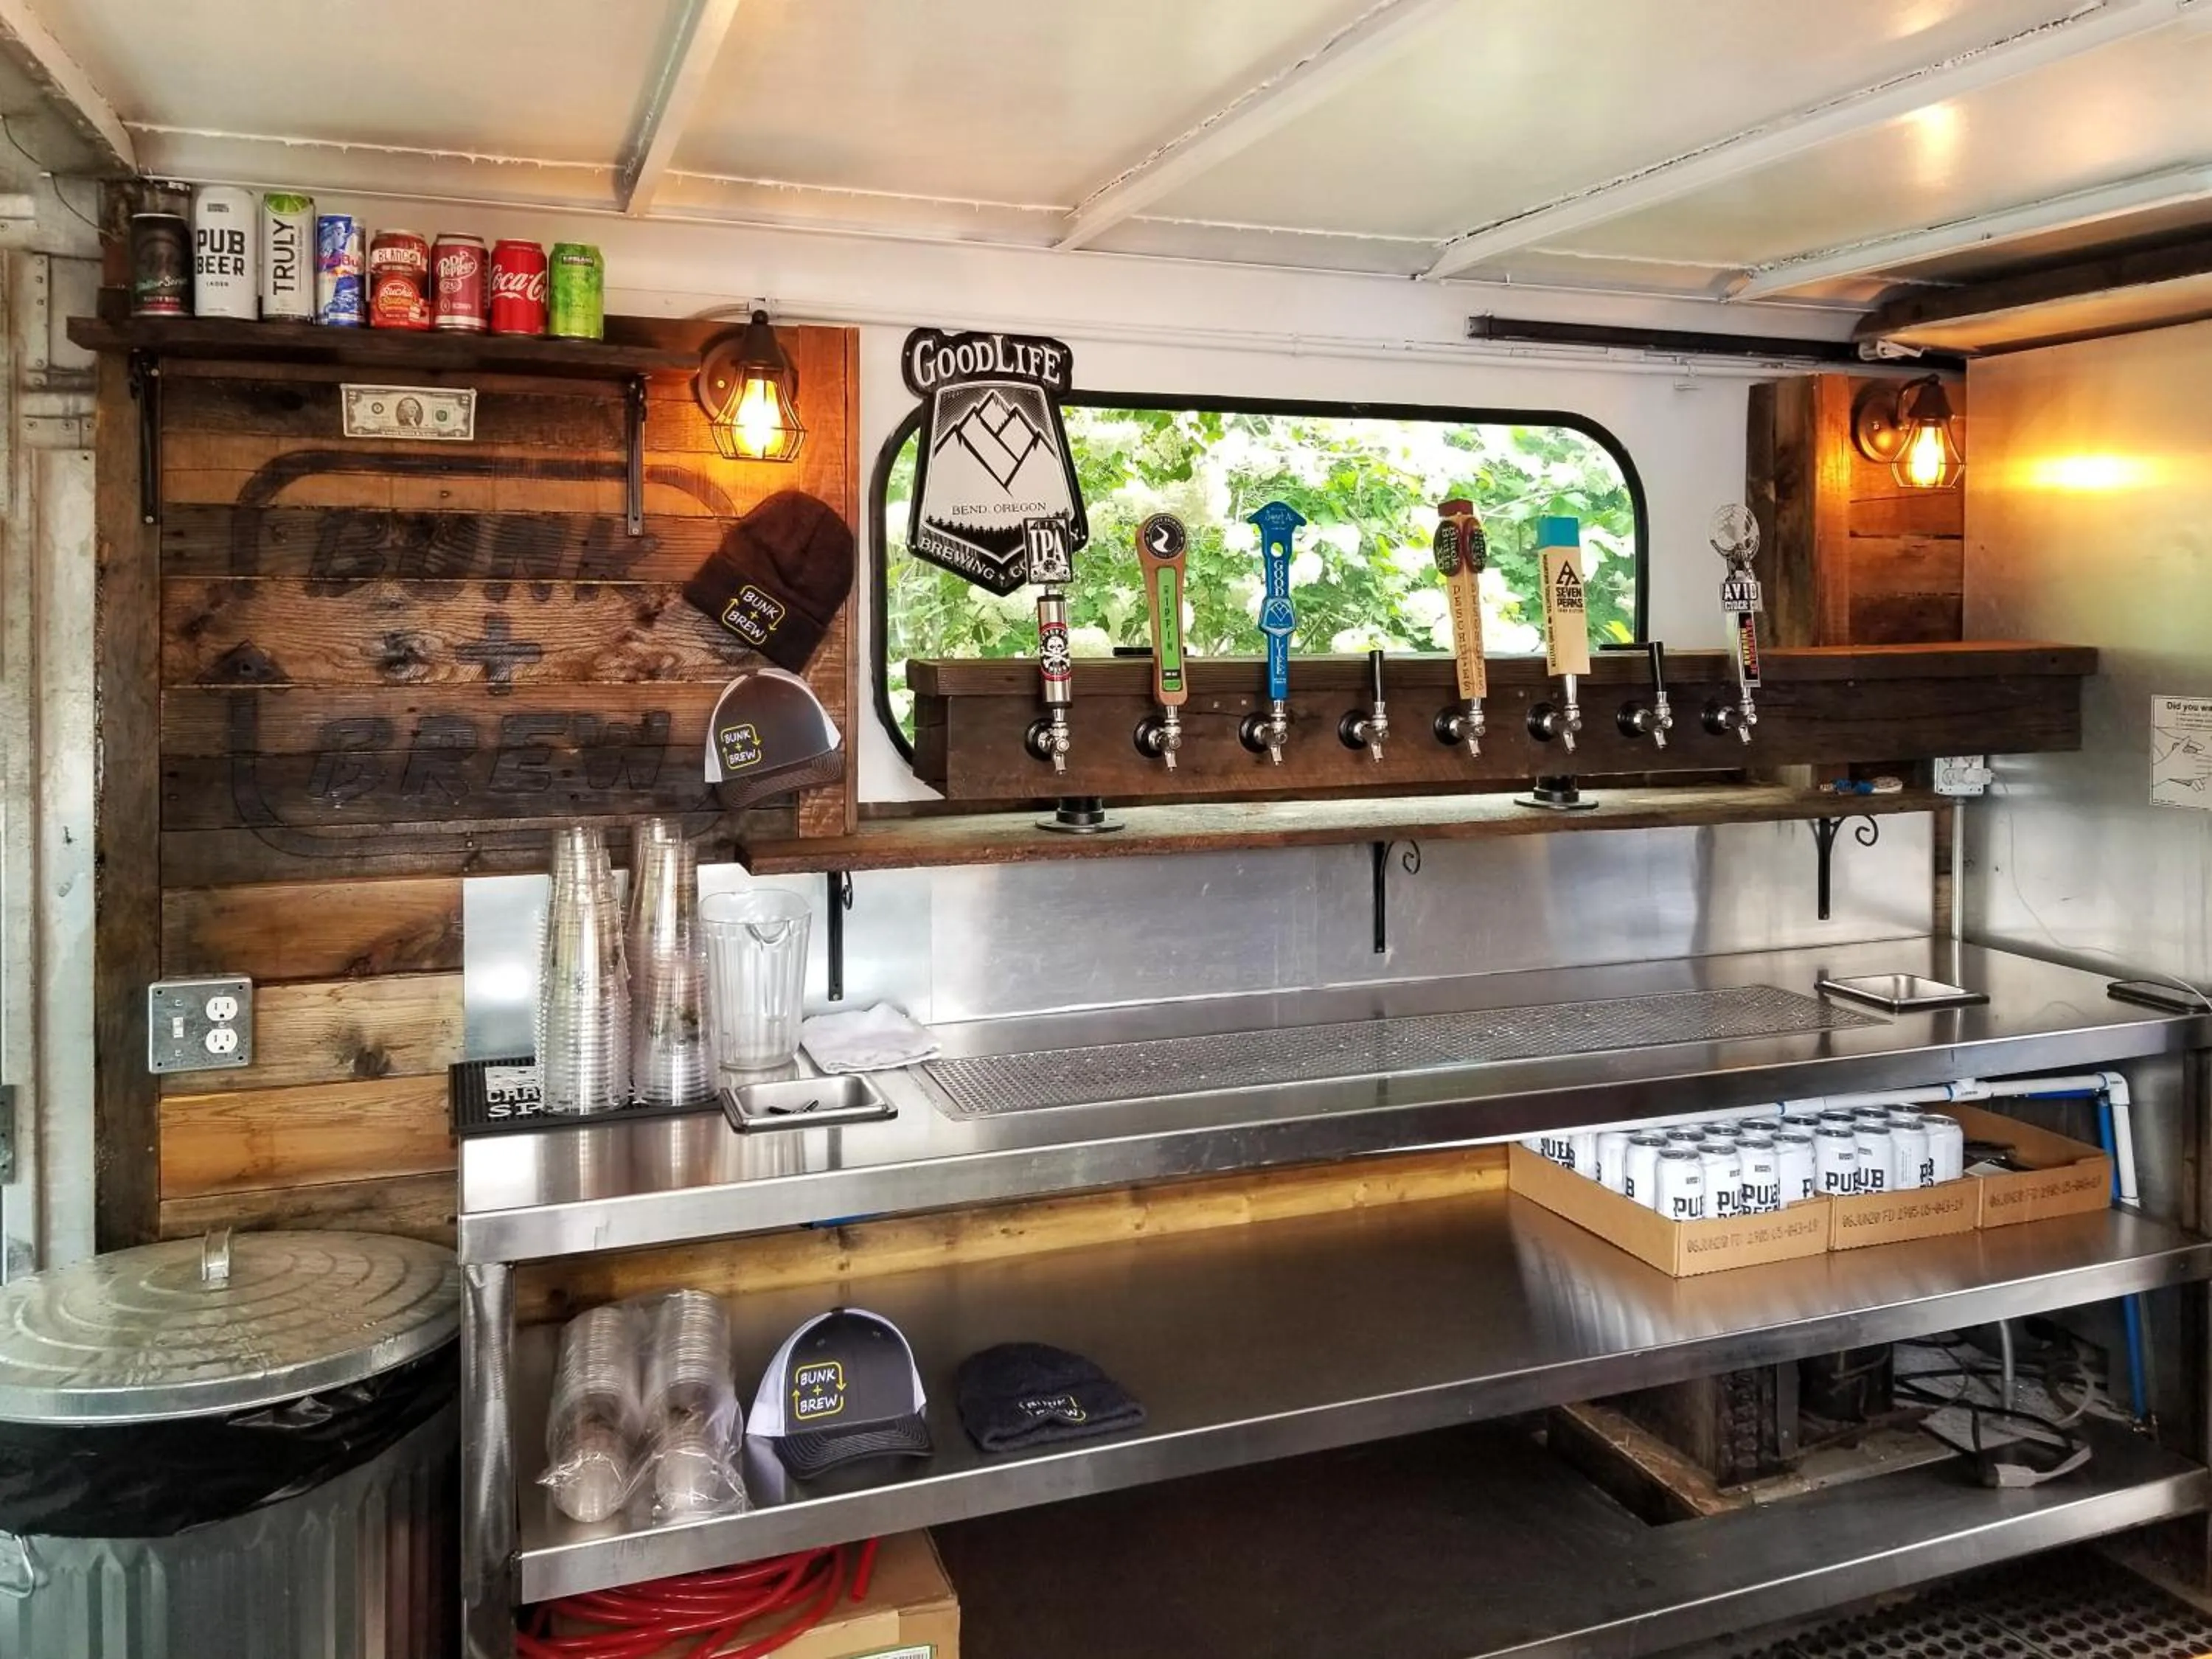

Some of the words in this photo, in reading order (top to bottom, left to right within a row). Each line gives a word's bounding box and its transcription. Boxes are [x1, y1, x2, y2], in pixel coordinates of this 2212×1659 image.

[196, 229, 246, 255] PUB
[196, 256, 245, 276] BEER
[273, 218, 295, 296] TRULY
[993, 502, 1047, 513] OREGON
[1029, 528, 1068, 566] IPA
[920, 537, 996, 580] BREWING
[1556, 587, 1582, 598] SEVEN
[1724, 583, 1757, 599] AVID
[742, 590, 779, 619] BUNK
[727, 610, 765, 639] BREW
[2166, 701, 2182, 711] Did
[724, 728, 751, 744] BUNK
[306, 710, 672, 801] BREW
[728, 748, 757, 765] BREW
[799, 1368, 837, 1386] BUNK
[799, 1393, 838, 1414] BREW
